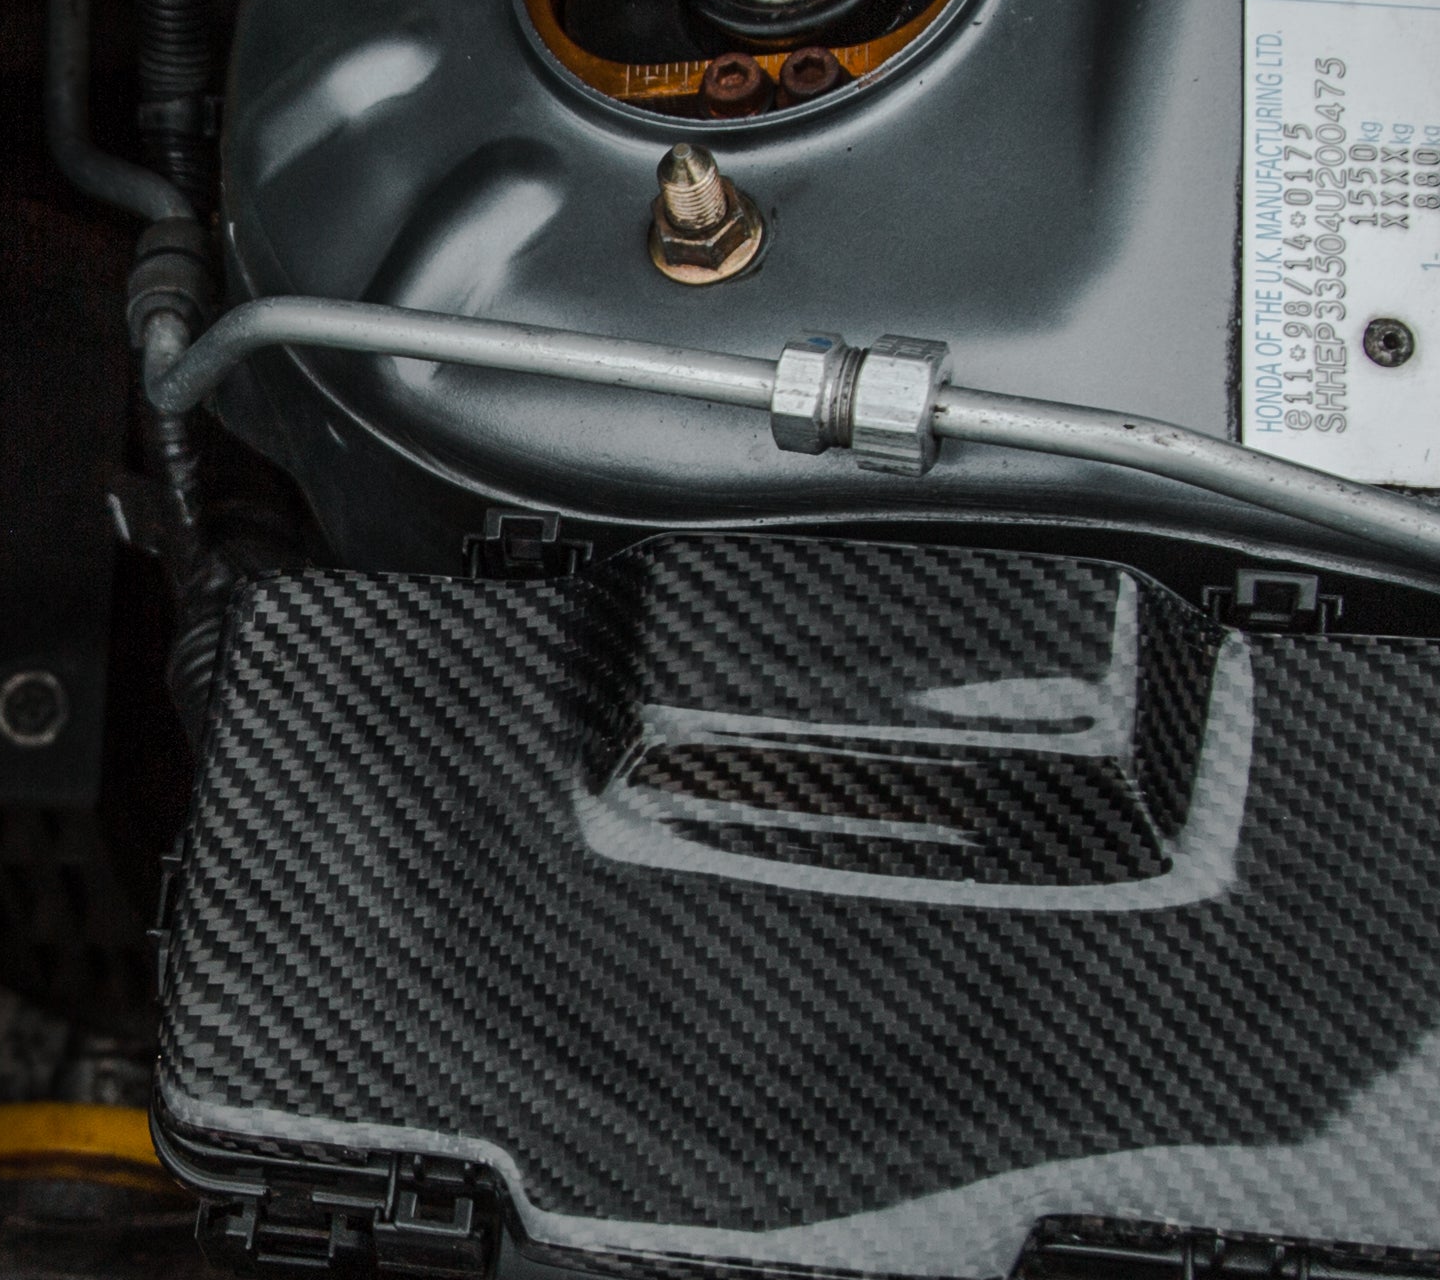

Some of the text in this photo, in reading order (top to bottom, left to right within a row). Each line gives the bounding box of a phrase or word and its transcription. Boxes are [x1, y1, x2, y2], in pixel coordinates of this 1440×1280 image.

[1255, 30, 1283, 433] HONDA OF THE U.K. MANUFACTURING LTD.
[1313, 57, 1348, 434] SHHEP33504U200475
